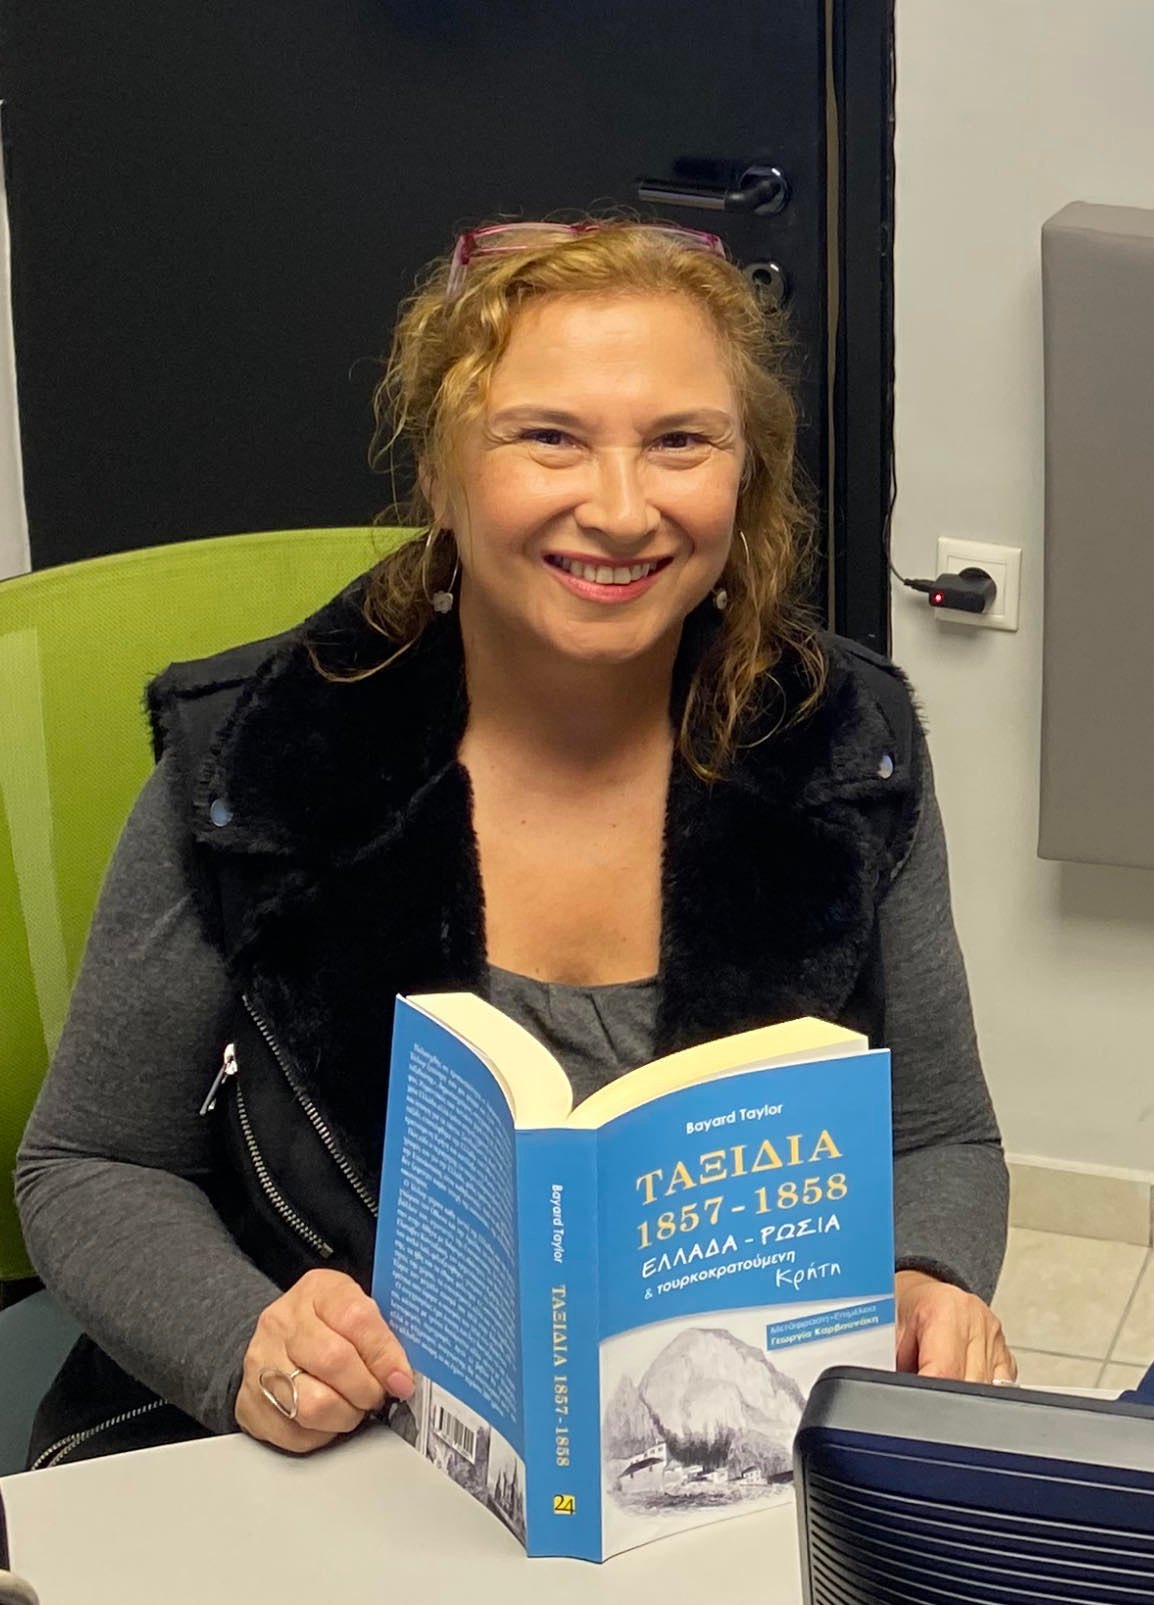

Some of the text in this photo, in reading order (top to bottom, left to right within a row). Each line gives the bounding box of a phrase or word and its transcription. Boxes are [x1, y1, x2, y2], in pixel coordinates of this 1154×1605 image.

[685, 1103, 784, 1135] Bayard Taylor
[635, 1128, 844, 1206] ΤΑΞΙΔΙΑ
[550, 1184, 565, 1264] Bayard Taylor
[641, 1234, 738, 1279] ΕΛΛΑΔΑ
[760, 1213, 841, 1246] ΡΩΣΙΑ
[643, 1250, 796, 1300] & τουρκοκρατούμενη
[775, 1261, 841, 1291] Κρήτη
[552, 1284, 568, 1367] ΤΑΞΙΔΙΑ
[553, 1494, 575, 1515] 24
